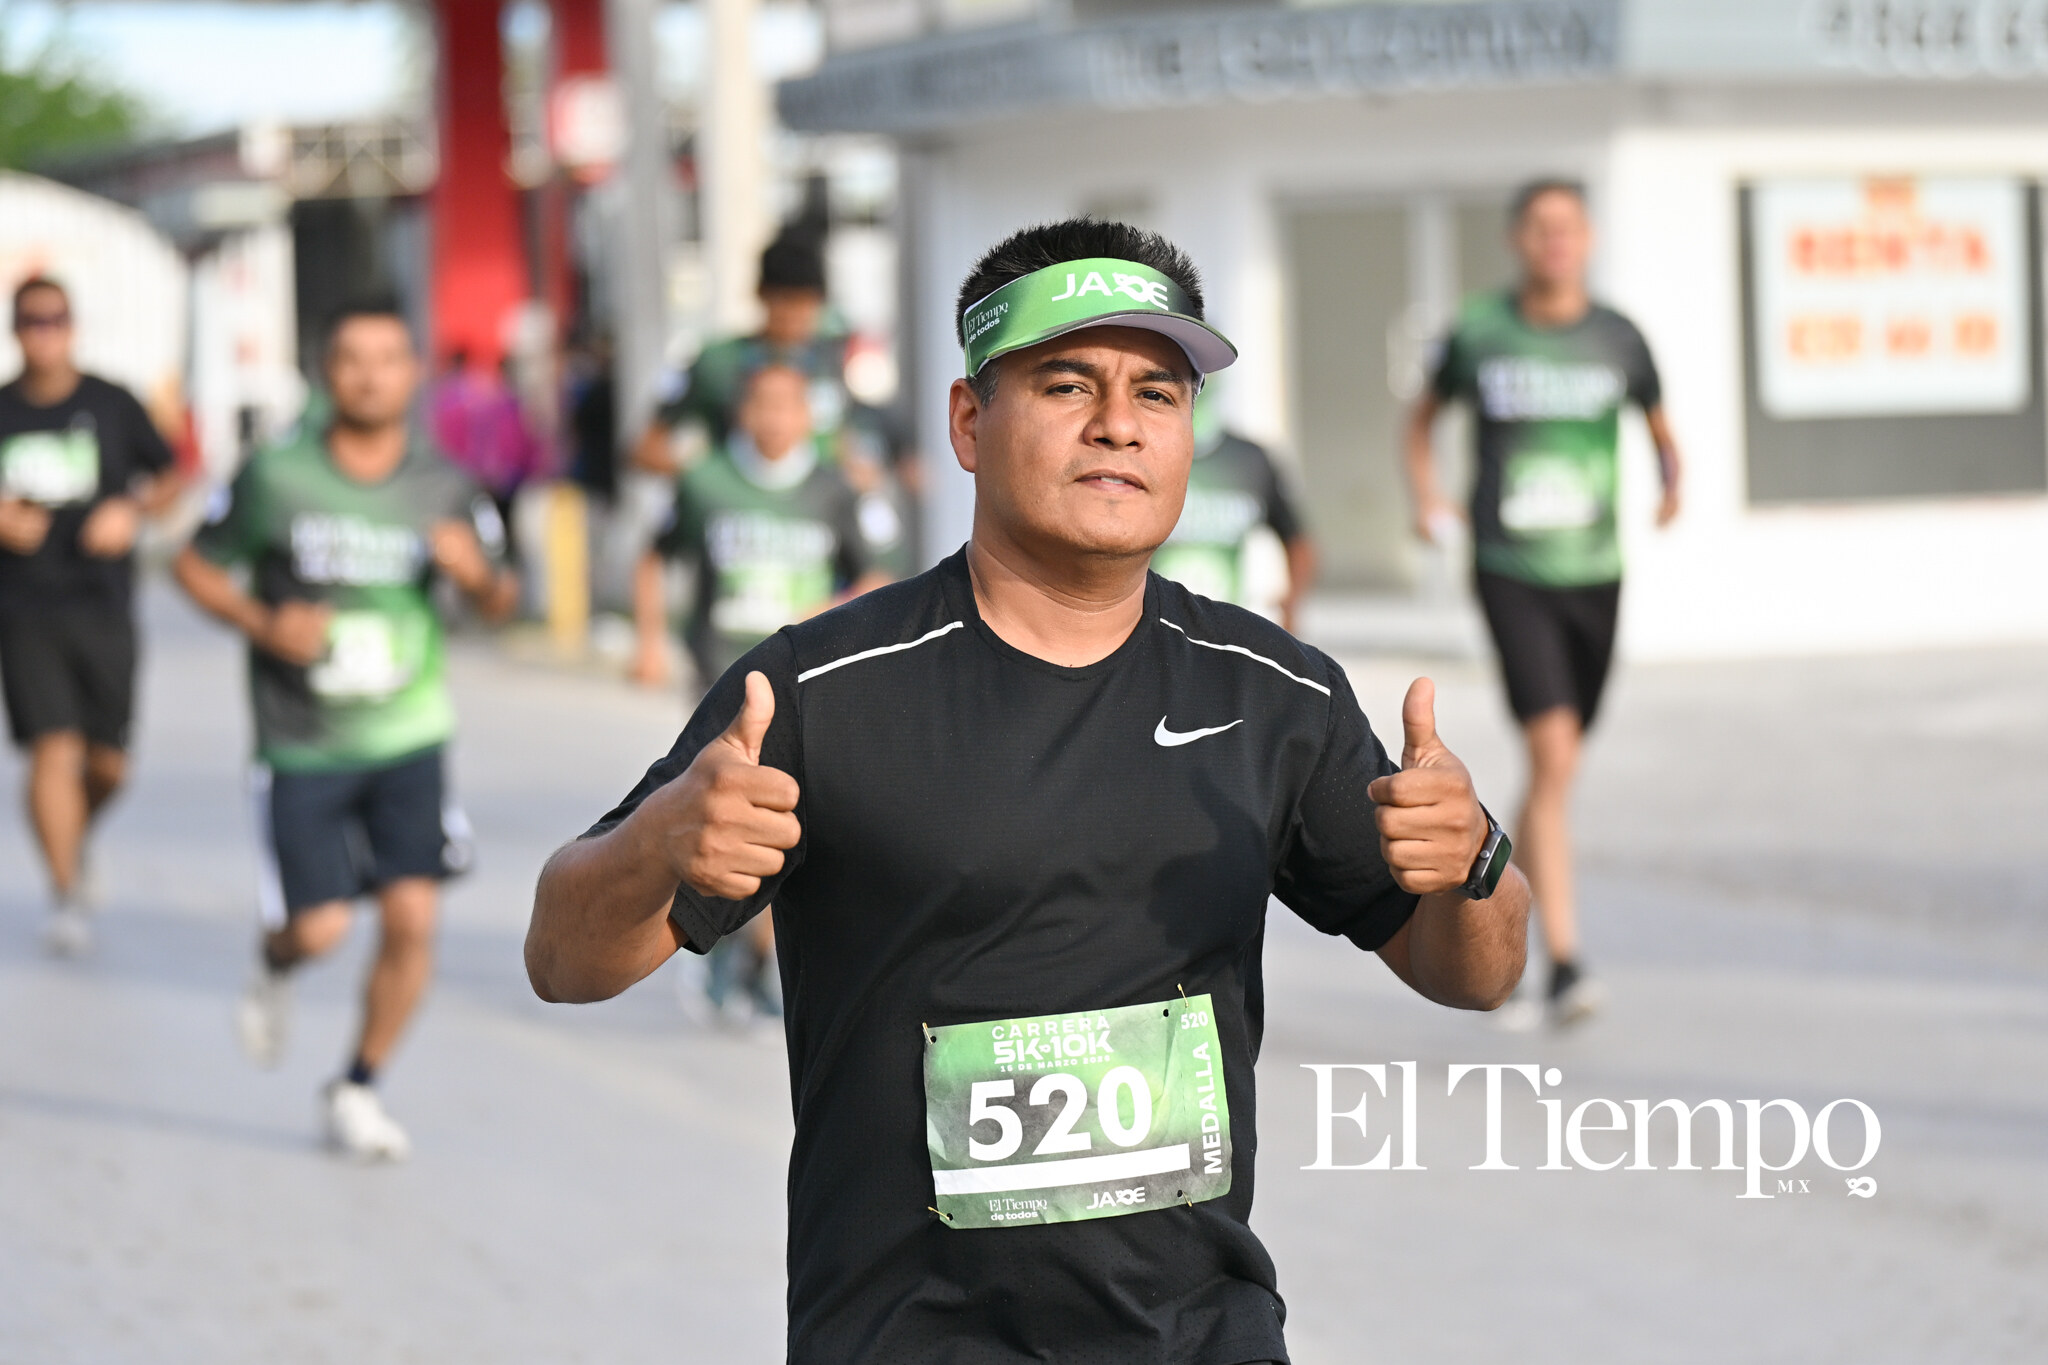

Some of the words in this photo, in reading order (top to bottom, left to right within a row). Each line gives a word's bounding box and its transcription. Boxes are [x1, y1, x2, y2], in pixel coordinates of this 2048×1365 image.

[976, 302, 1009, 327] Tiempo
[969, 333, 977, 344] de
[977, 317, 1000, 336] todos
[992, 1015, 1110, 1040] CARRERA
[1181, 1011, 1209, 1030] 520
[1018, 1062, 1032, 1071] DE
[1038, 1058, 1078, 1069] MARZO
[969, 1065, 1151, 1161] 520
[1192, 1041, 1223, 1175] MEDALLA
[988, 1198, 999, 1212] El
[1000, 1198, 1048, 1212] Tiempo
[990, 1211, 1004, 1221] de
[1005, 1211, 1038, 1220] todos
